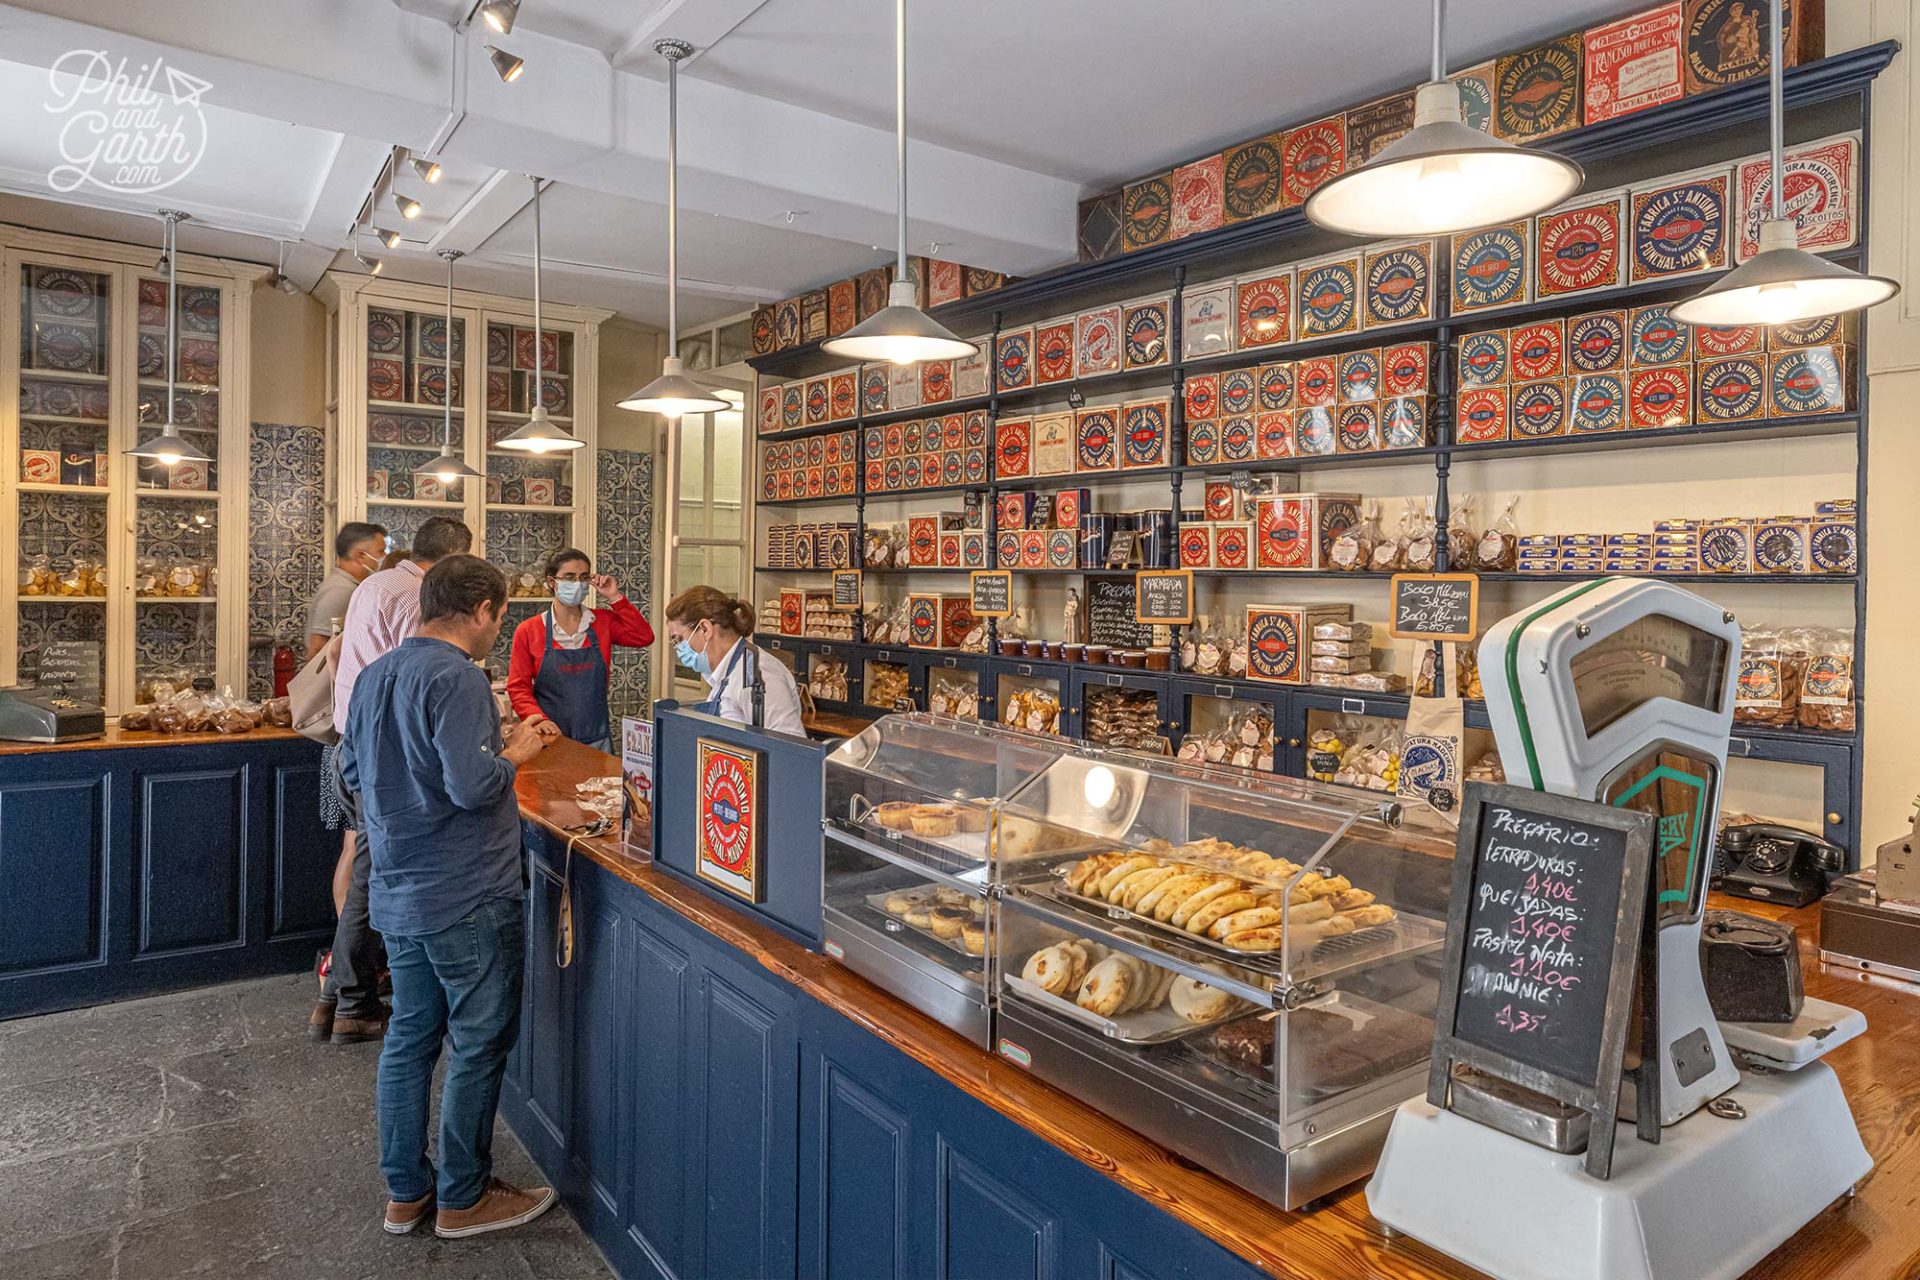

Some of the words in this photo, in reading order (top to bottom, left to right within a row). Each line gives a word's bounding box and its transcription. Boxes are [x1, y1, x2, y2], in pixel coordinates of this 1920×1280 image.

[1501, 58, 1531, 96] FABRICA
[1544, 49, 1577, 80] ANTONIO
[1720, 56, 1757, 71] MARIA
[1727, 70, 1751, 83] ILHA
[1808, 162, 1838, 209] MADEIRENSE
[1640, 196, 1671, 232] FABRICA
[1684, 190, 1720, 222] ANTONIO
[1543, 218, 1572, 252] FABRICA
[1584, 214, 1614, 242] ANTONIO
[1458, 238, 1484, 270] FABRICA
[1494, 233, 1522, 260] ANTONIO
[1370, 257, 1392, 286] FABRICA
[1401, 253, 1426, 280] ANTONIO
[1302, 273, 1322, 302] FABRICA
[1330, 268, 1354, 294] ANTONIO
[1572, 322, 1592, 344] FABRICA
[1600, 318, 1622, 340] ANTONIO
[1632, 313, 1654, 336] FABRICA
[1462, 340, 1478, 360] FABRICA
[1485, 336, 1504, 356] ANTONIO
[1514, 332, 1532, 354] FABRICA
[1540, 328, 1560, 348] ANTONIO
[1702, 366, 1727, 390] FABRICA
[1736, 362, 1761, 386] ANTONIO
[1774, 356, 1800, 382] FABRICA
[1516, 388, 1534, 409] FABRICA
[1542, 384, 1562, 406] ANTONIO
[1600, 378, 1622, 400] ANTONIO
[1632, 375, 1654, 398] FABRICA
[1663, 371, 1686, 394] ANTONIO
[1461, 394, 1478, 416] FABRICA
[1486, 390, 1504, 412] ANTONIO
[1250, 616, 1269, 642] FABRICA
[1278, 616, 1296, 644] ANTONIO
[730, 764, 750, 814] ANTONIO
[1524, 872, 1578, 902] 1,40€
[1510, 916, 1577, 942] 1,40€
